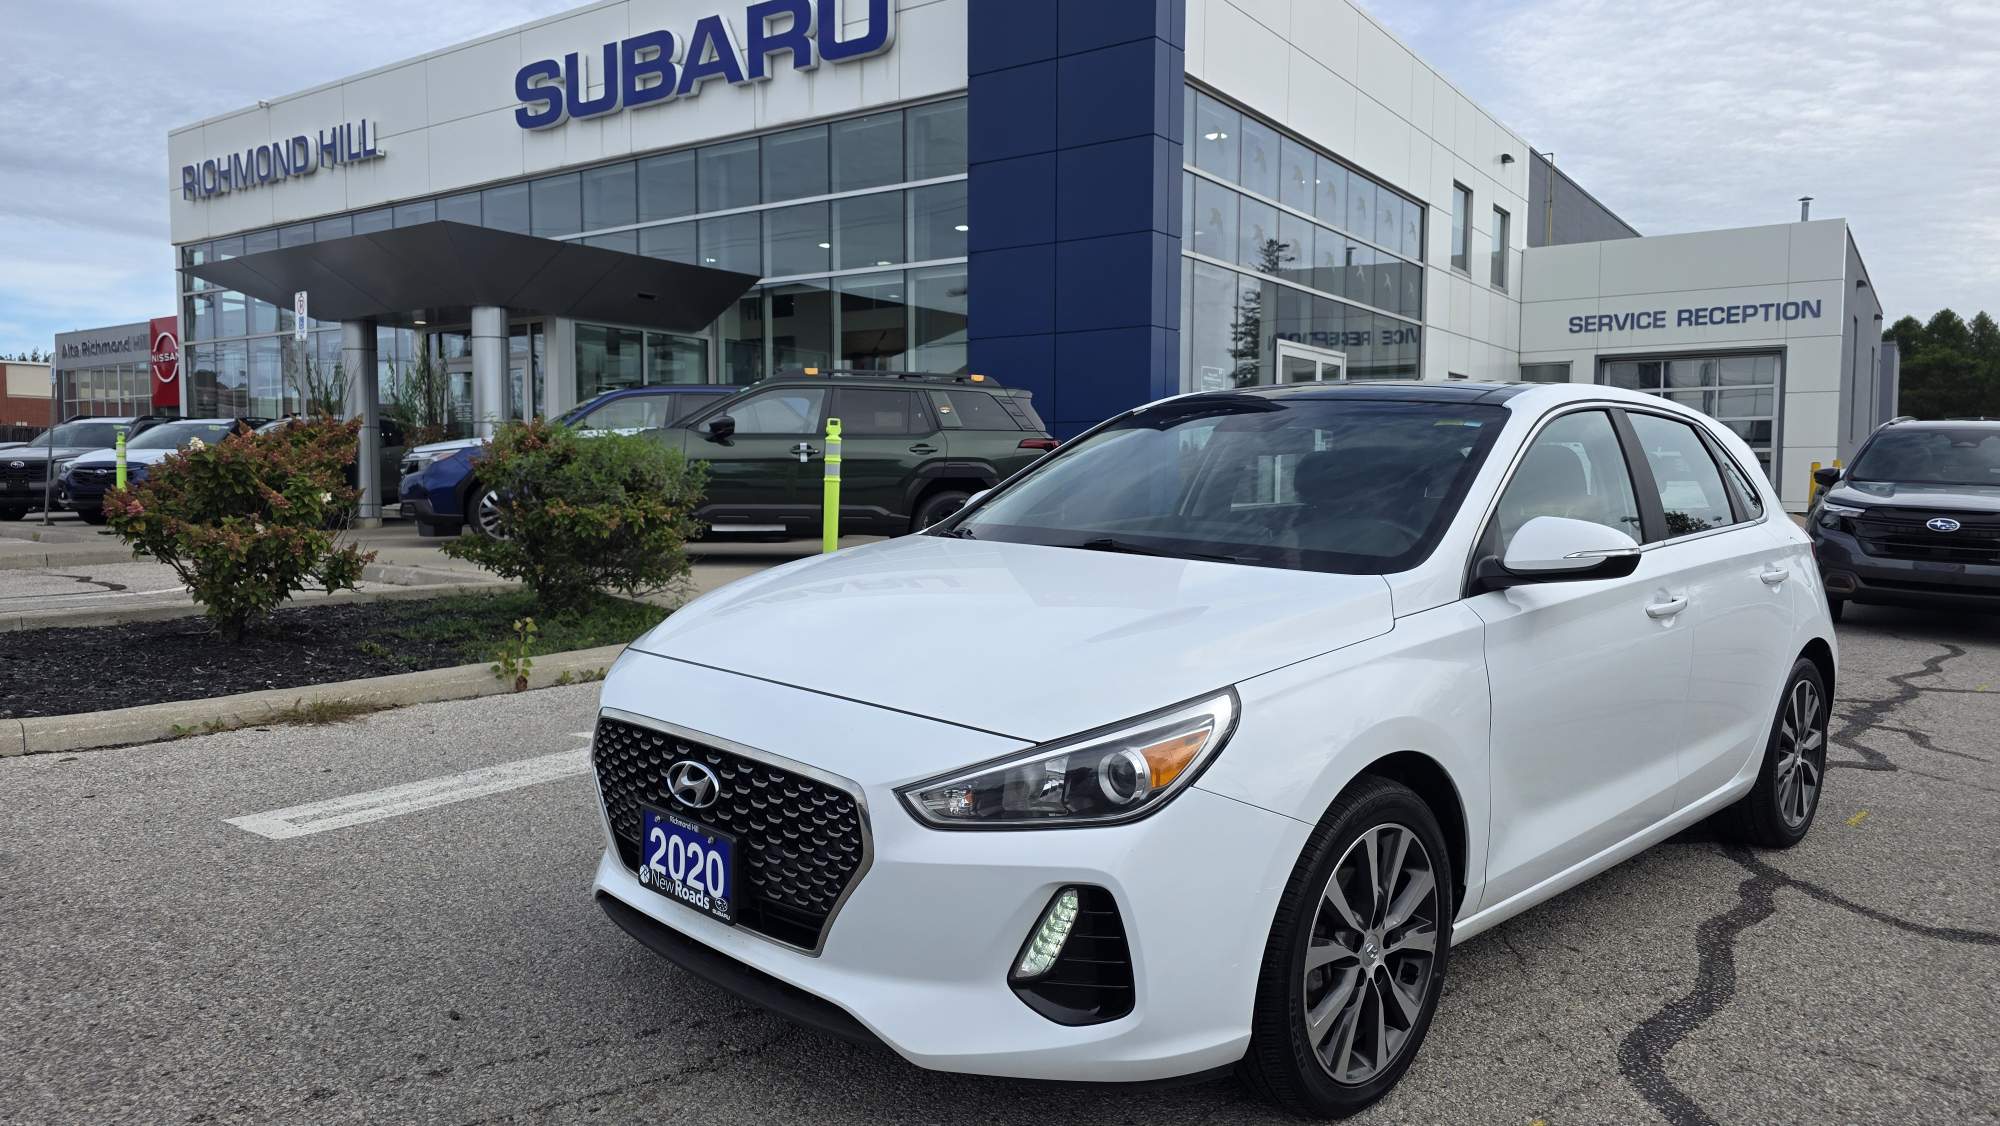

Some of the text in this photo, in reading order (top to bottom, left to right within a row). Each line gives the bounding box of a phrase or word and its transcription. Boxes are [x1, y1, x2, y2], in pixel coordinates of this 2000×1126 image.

[515, 0, 891, 130] SUBARU
[182, 118, 381, 201] RICHMOND HILL
[61, 342, 80, 360] Alta
[81, 336, 130, 358] Richmond
[1568, 299, 1822, 334] SERVICE RECEPTION
[649, 827, 724, 898] 2020
